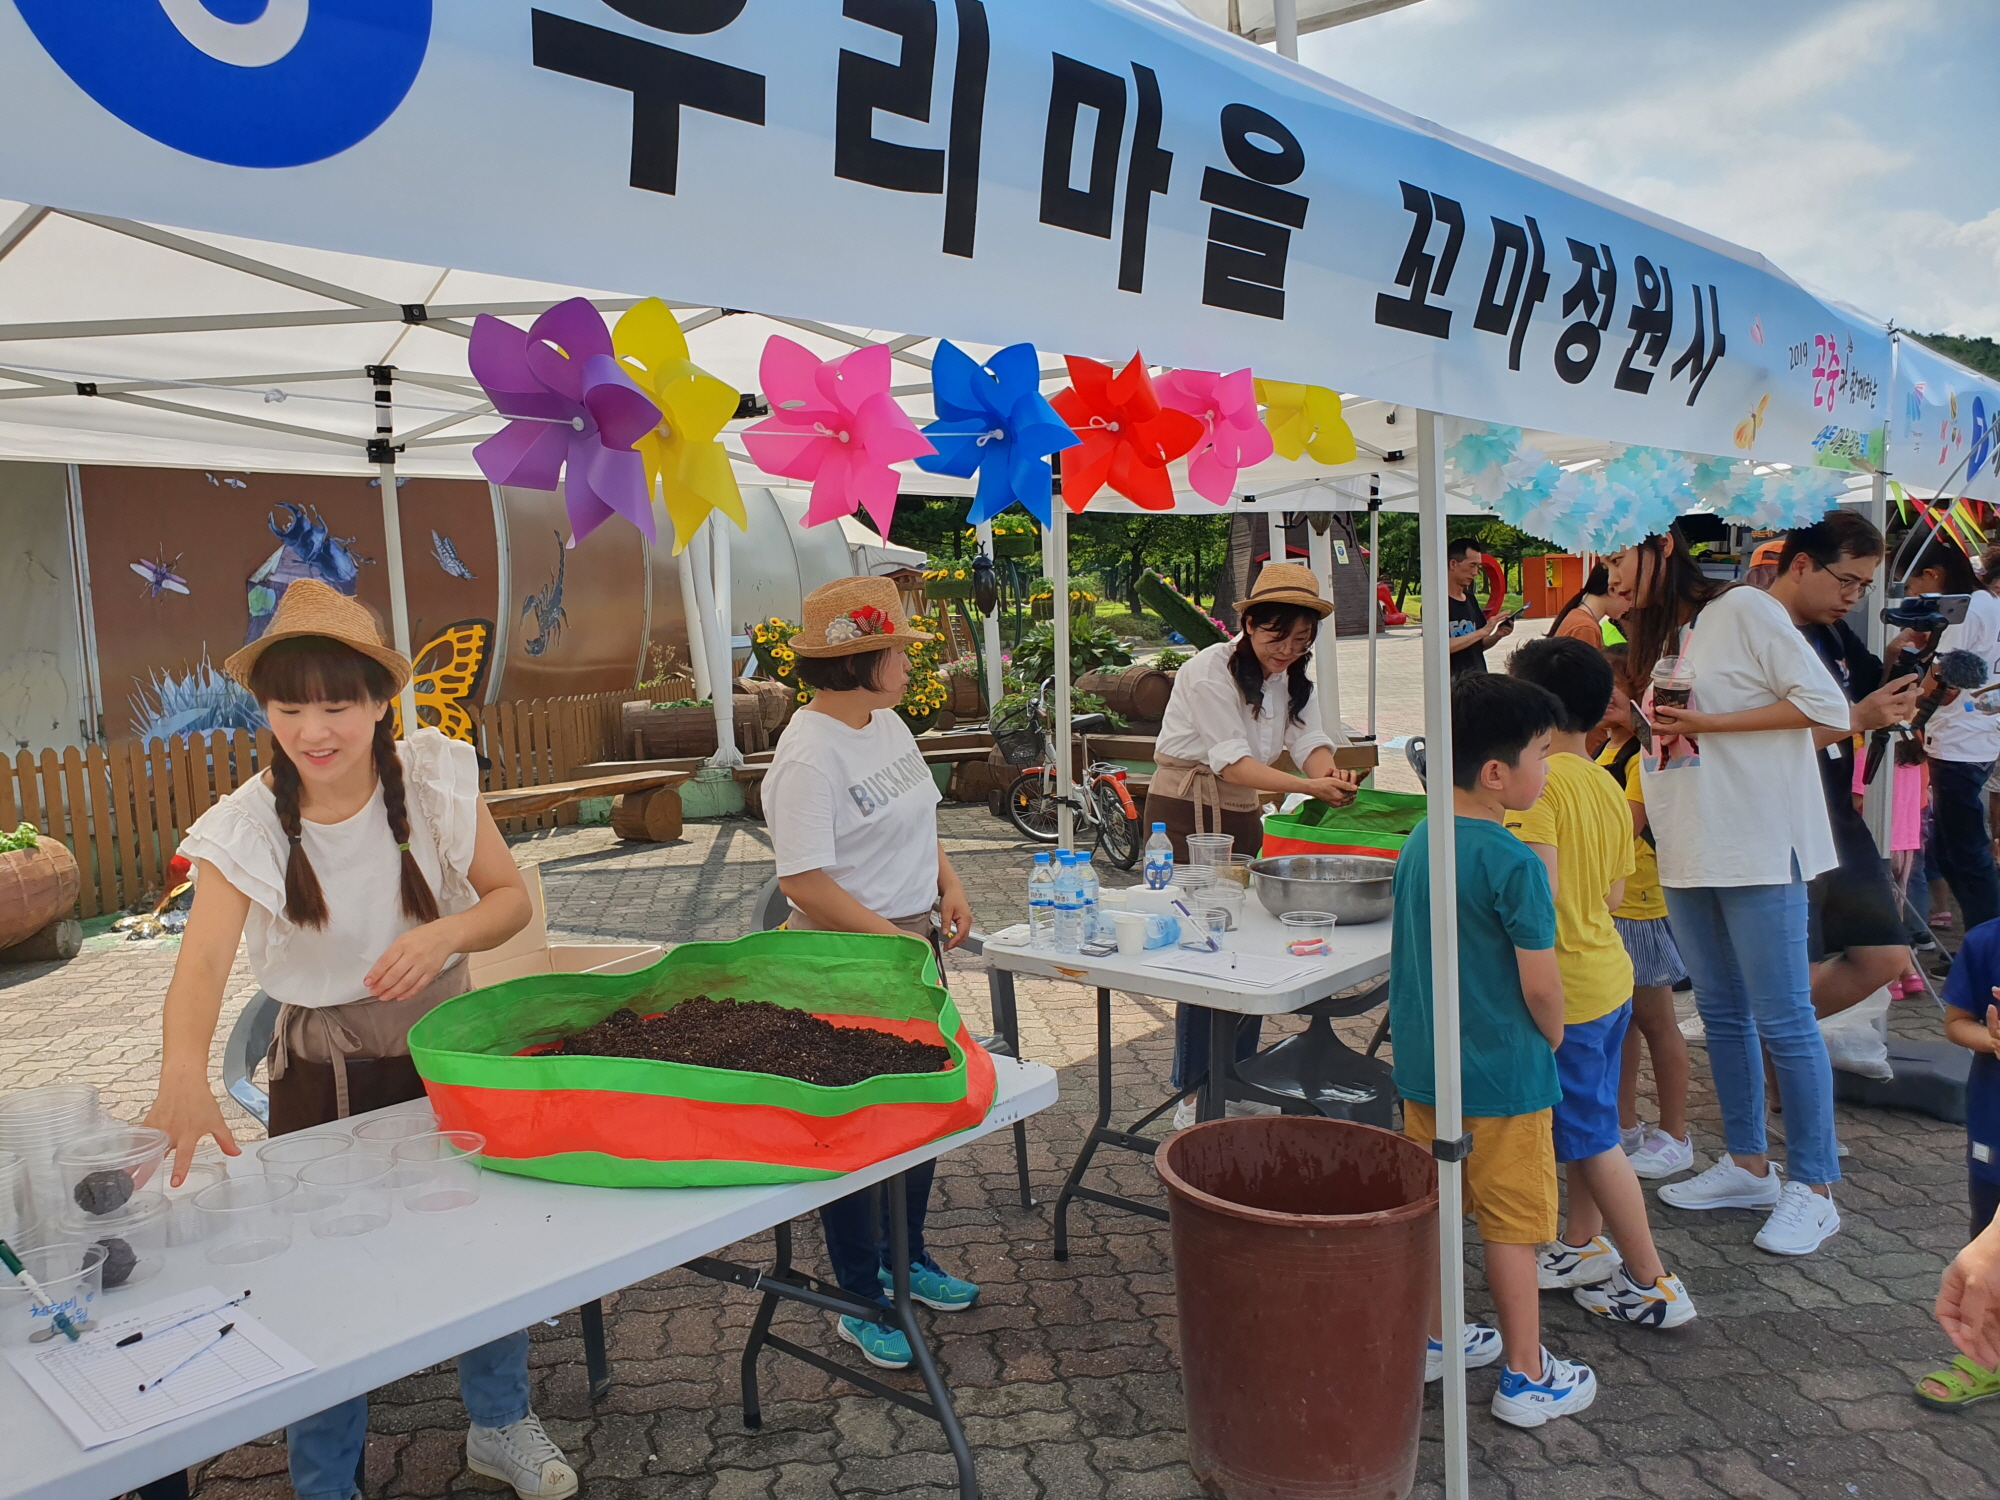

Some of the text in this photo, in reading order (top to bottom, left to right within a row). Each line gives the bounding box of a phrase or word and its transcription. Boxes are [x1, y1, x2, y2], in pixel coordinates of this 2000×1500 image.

[531, 0, 1726, 407] 우리마을 꼬마정원사
[1788, 341, 1808, 371] 2019
[1530, 1394, 1545, 1402] FILA
